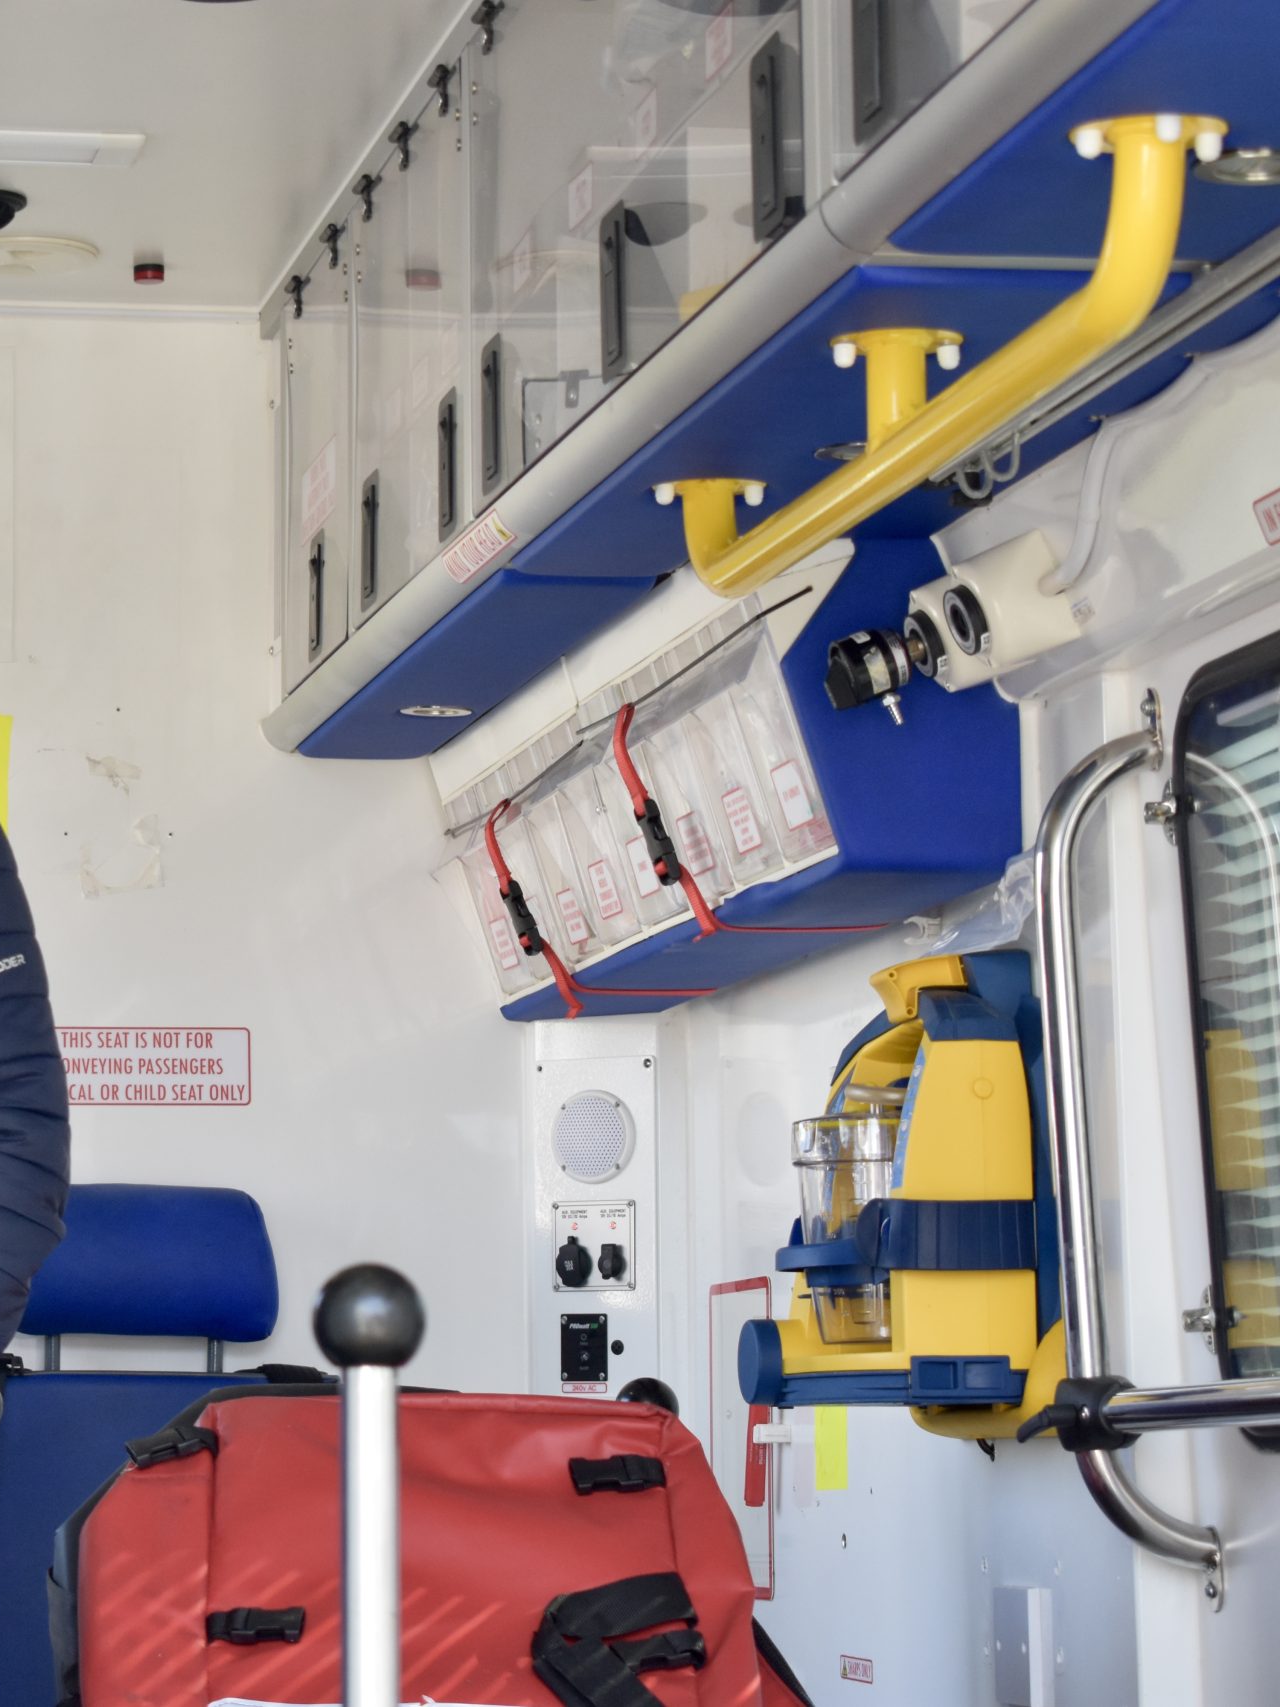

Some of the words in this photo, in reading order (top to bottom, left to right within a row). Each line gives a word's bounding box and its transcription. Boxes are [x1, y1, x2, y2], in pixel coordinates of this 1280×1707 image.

[61, 1031, 92, 1049] THIS
[97, 1031, 129, 1049] SEAT
[135, 1031, 148, 1049] IS
[153, 1031, 181, 1049] NOT
[186, 1031, 213, 1049] FOR
[61, 1057, 133, 1075] ONVEYING
[138, 1057, 224, 1075] PASSENGERS
[100, 1083, 119, 1101] OR
[125, 1083, 166, 1101] CHILD
[172, 1083, 204, 1101] SEAT
[209, 1083, 245, 1101] ONLY
